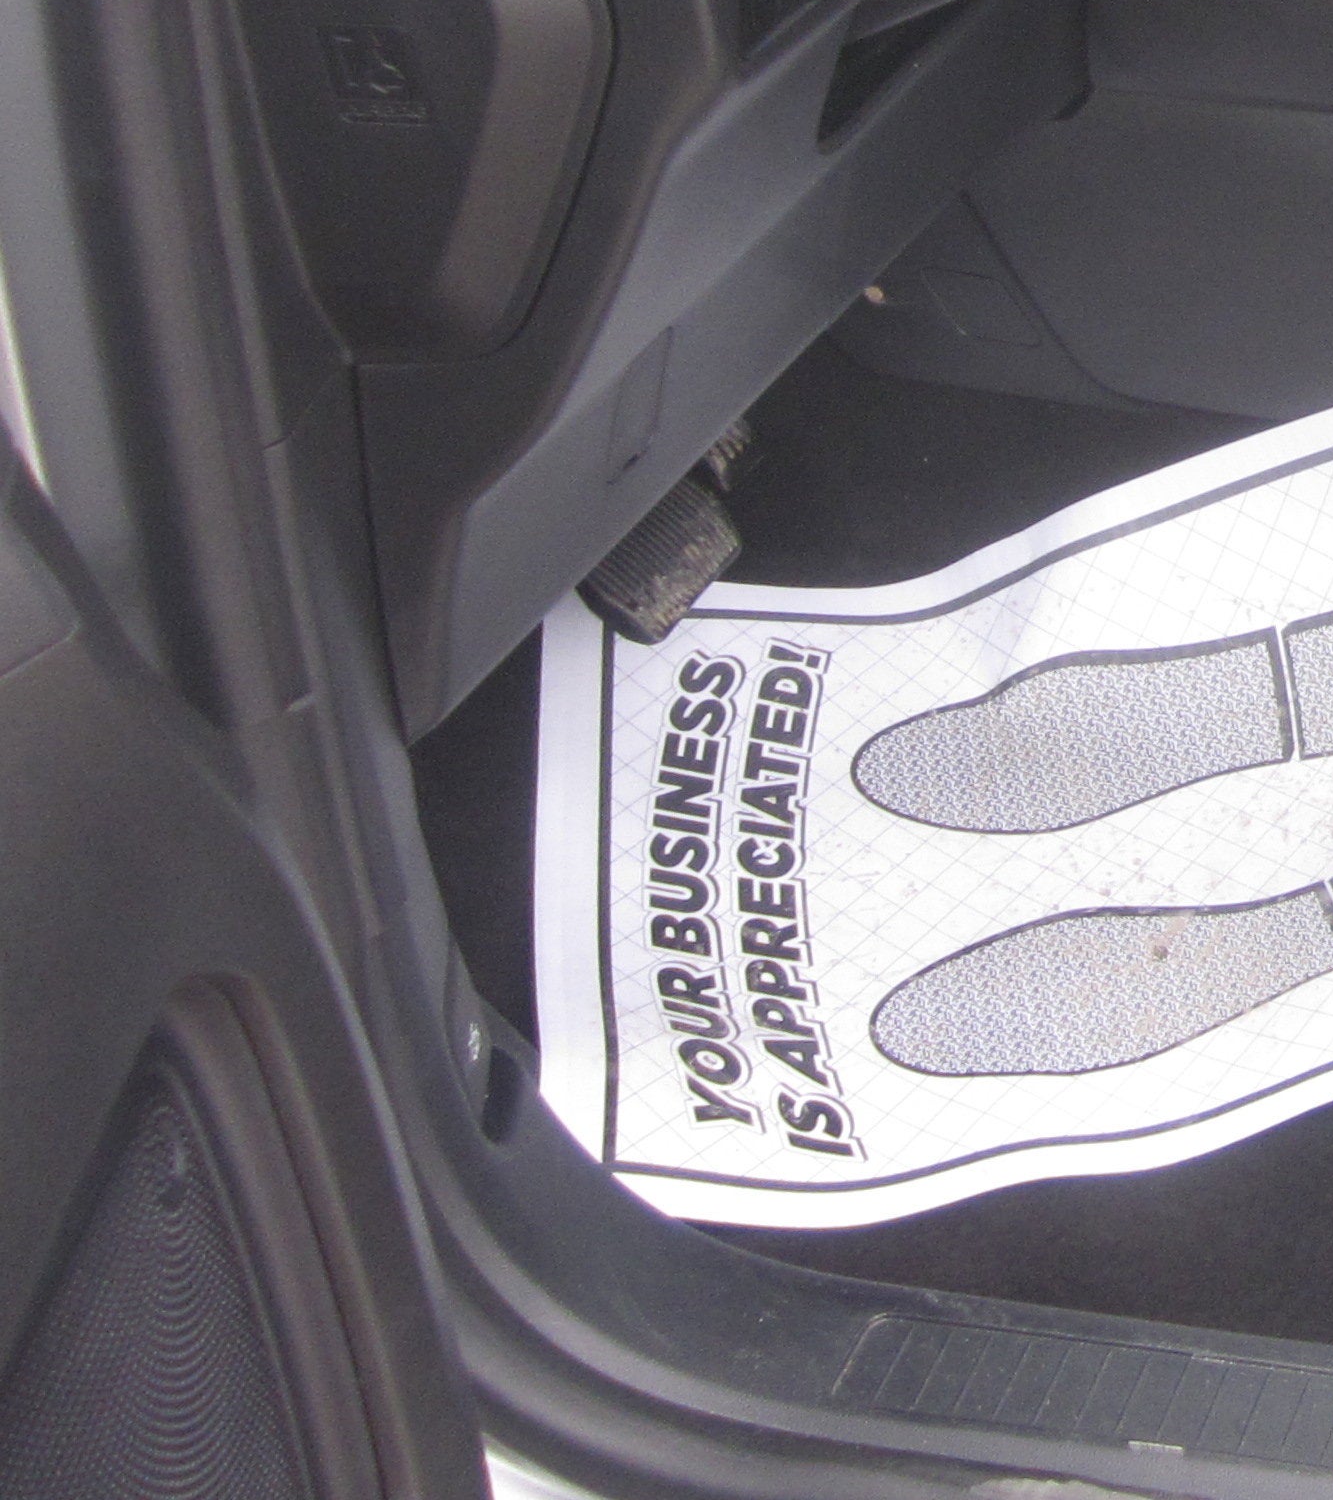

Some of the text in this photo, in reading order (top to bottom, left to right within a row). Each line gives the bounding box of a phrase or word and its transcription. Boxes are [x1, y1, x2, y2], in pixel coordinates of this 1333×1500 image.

[649, 657, 754, 1127] YOUR BUSINESS
[737, 644, 855, 1157] IS APPRECIATED!
